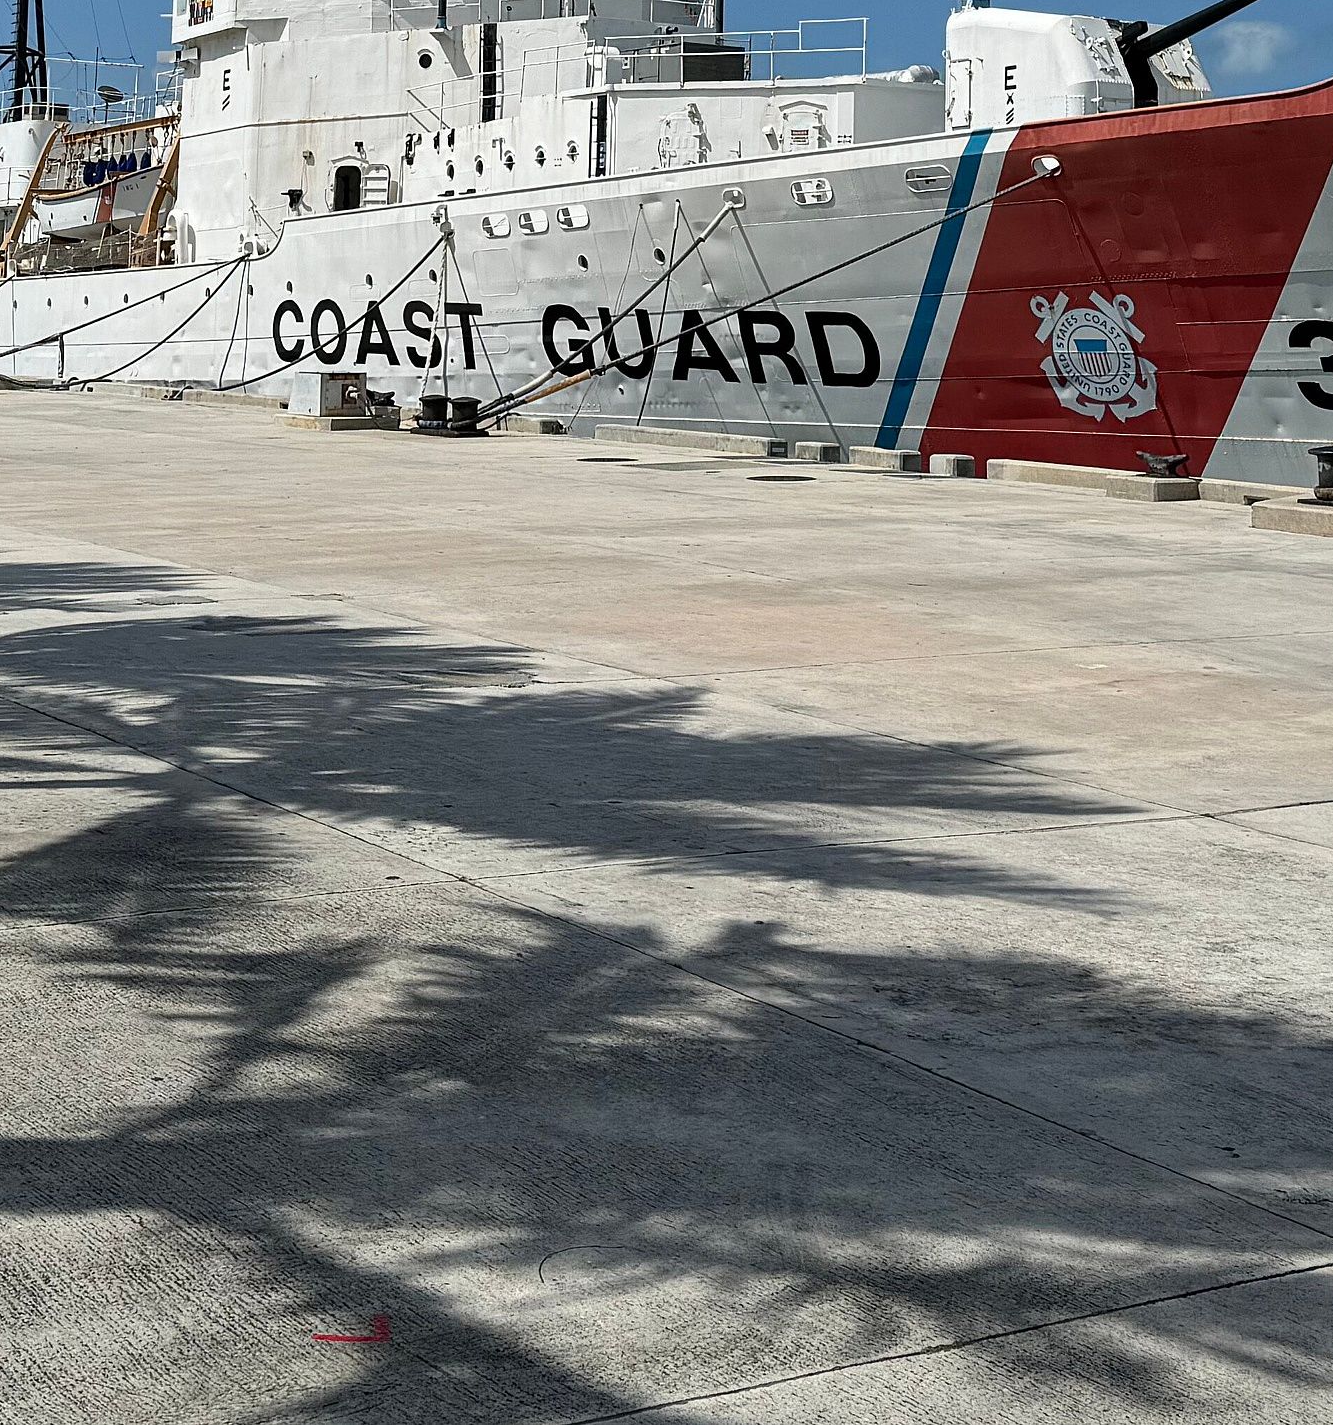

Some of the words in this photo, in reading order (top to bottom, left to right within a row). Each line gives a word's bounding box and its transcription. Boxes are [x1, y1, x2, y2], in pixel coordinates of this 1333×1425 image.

[223, 69, 231, 91] E
[1005, 65, 1017, 90] E
[1056, 314, 1078, 348] STATES
[1084, 313, 1122, 339] COAST
[272, 298, 483, 370] COAST
[541, 303, 881, 388] GUARD
[1058, 353, 1091, 392] UNITED
[1119, 342, 1132, 386] GUARD
[1095, 384, 1120, 396] 1790
